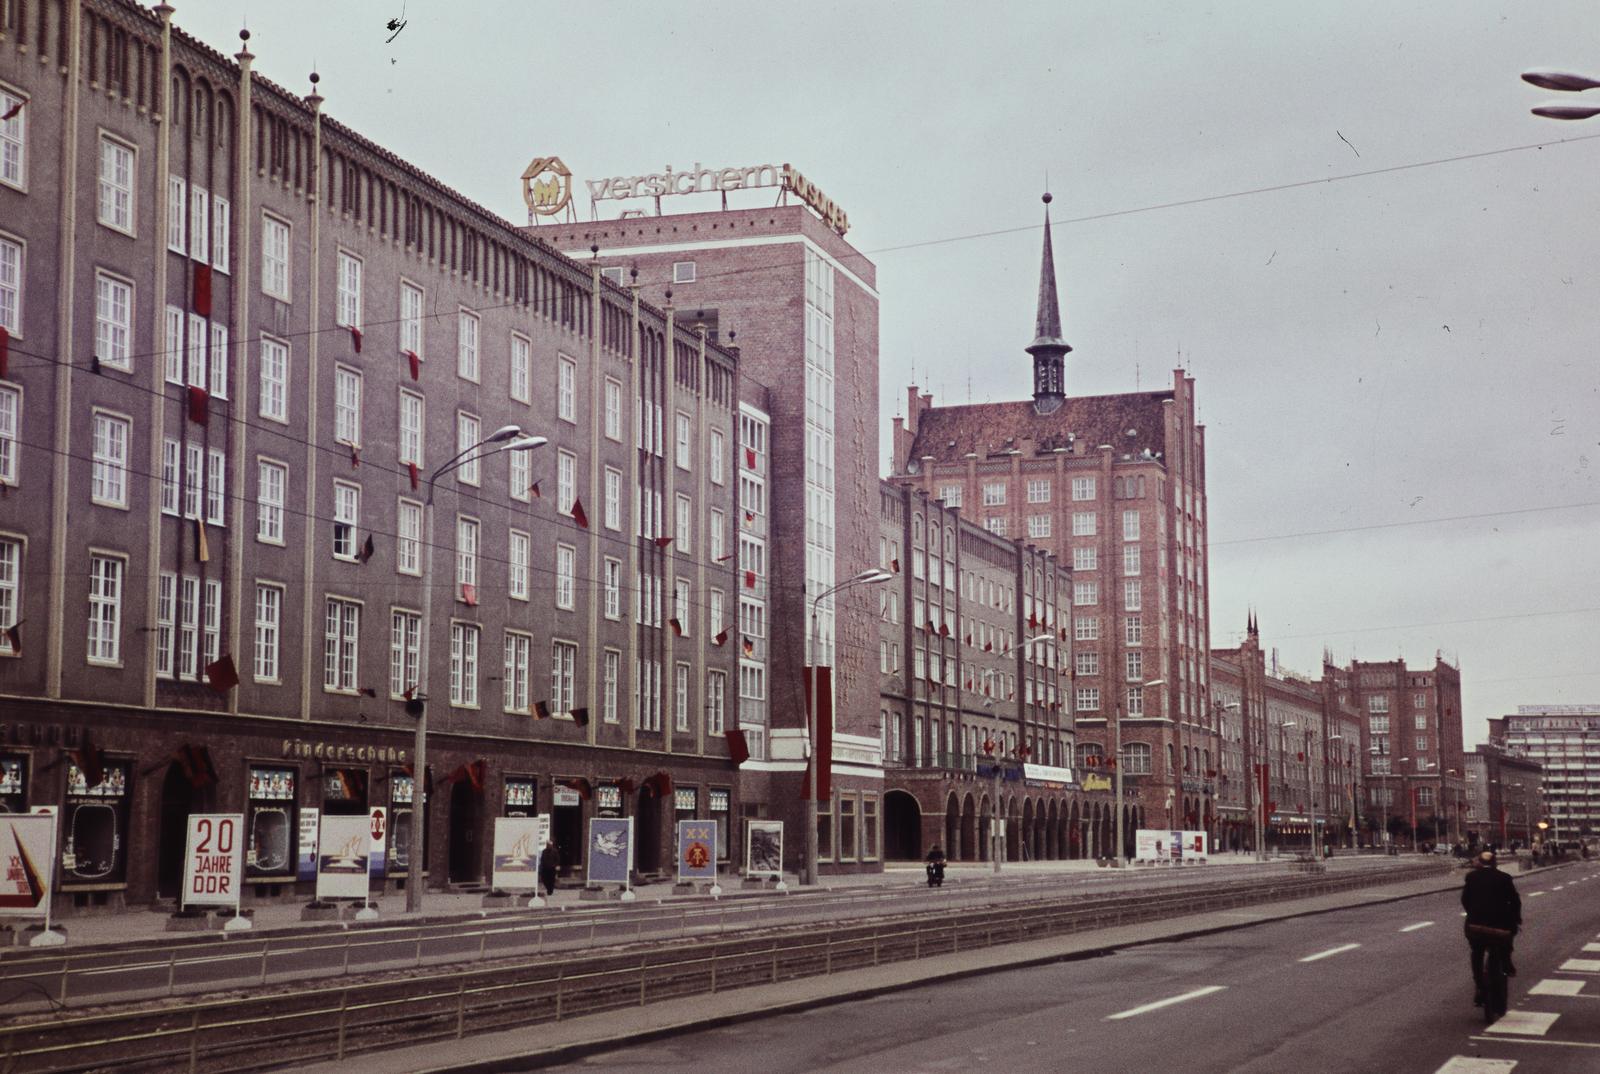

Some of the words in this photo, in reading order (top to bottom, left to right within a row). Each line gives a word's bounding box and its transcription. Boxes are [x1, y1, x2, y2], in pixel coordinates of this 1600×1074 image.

[585, 162, 778, 201] versichern
[196, 819, 233, 853] 20
[195, 855, 232, 873] JAHRE
[193, 876, 230, 893] DDR
